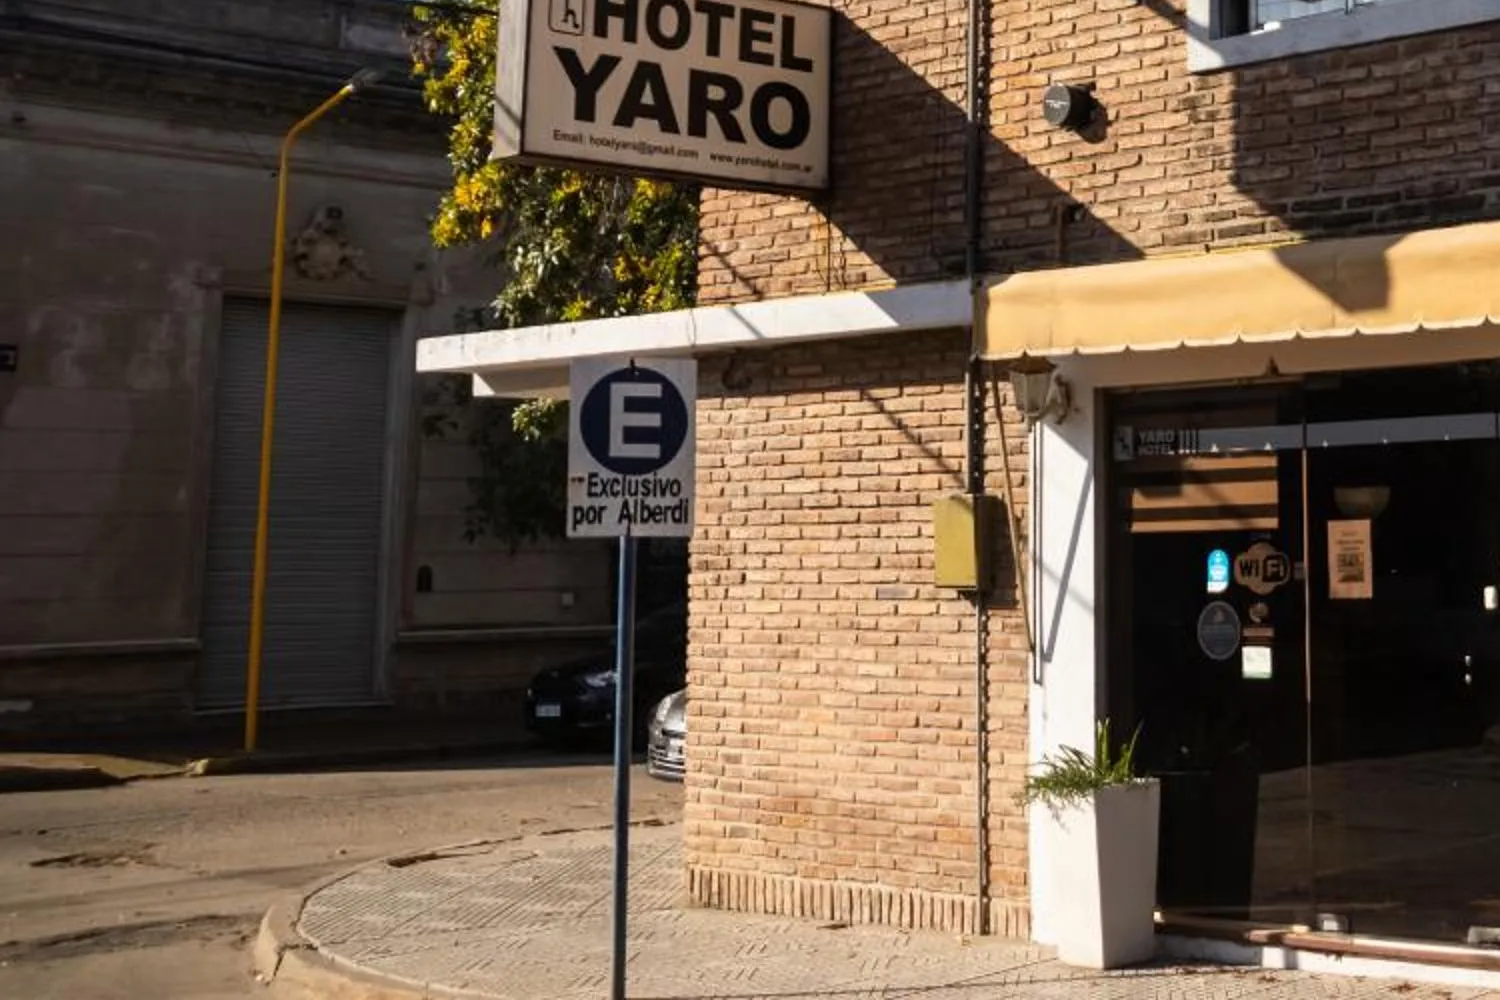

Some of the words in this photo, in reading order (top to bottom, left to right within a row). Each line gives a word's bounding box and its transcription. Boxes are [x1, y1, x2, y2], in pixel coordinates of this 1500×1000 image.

[553, 45, 811, 151] YARO
[609, 381, 663, 460] E
[586, 471, 682, 498] Exclusivo
[572, 504, 608, 531] por
[618, 498, 690, 525] Alberdi
